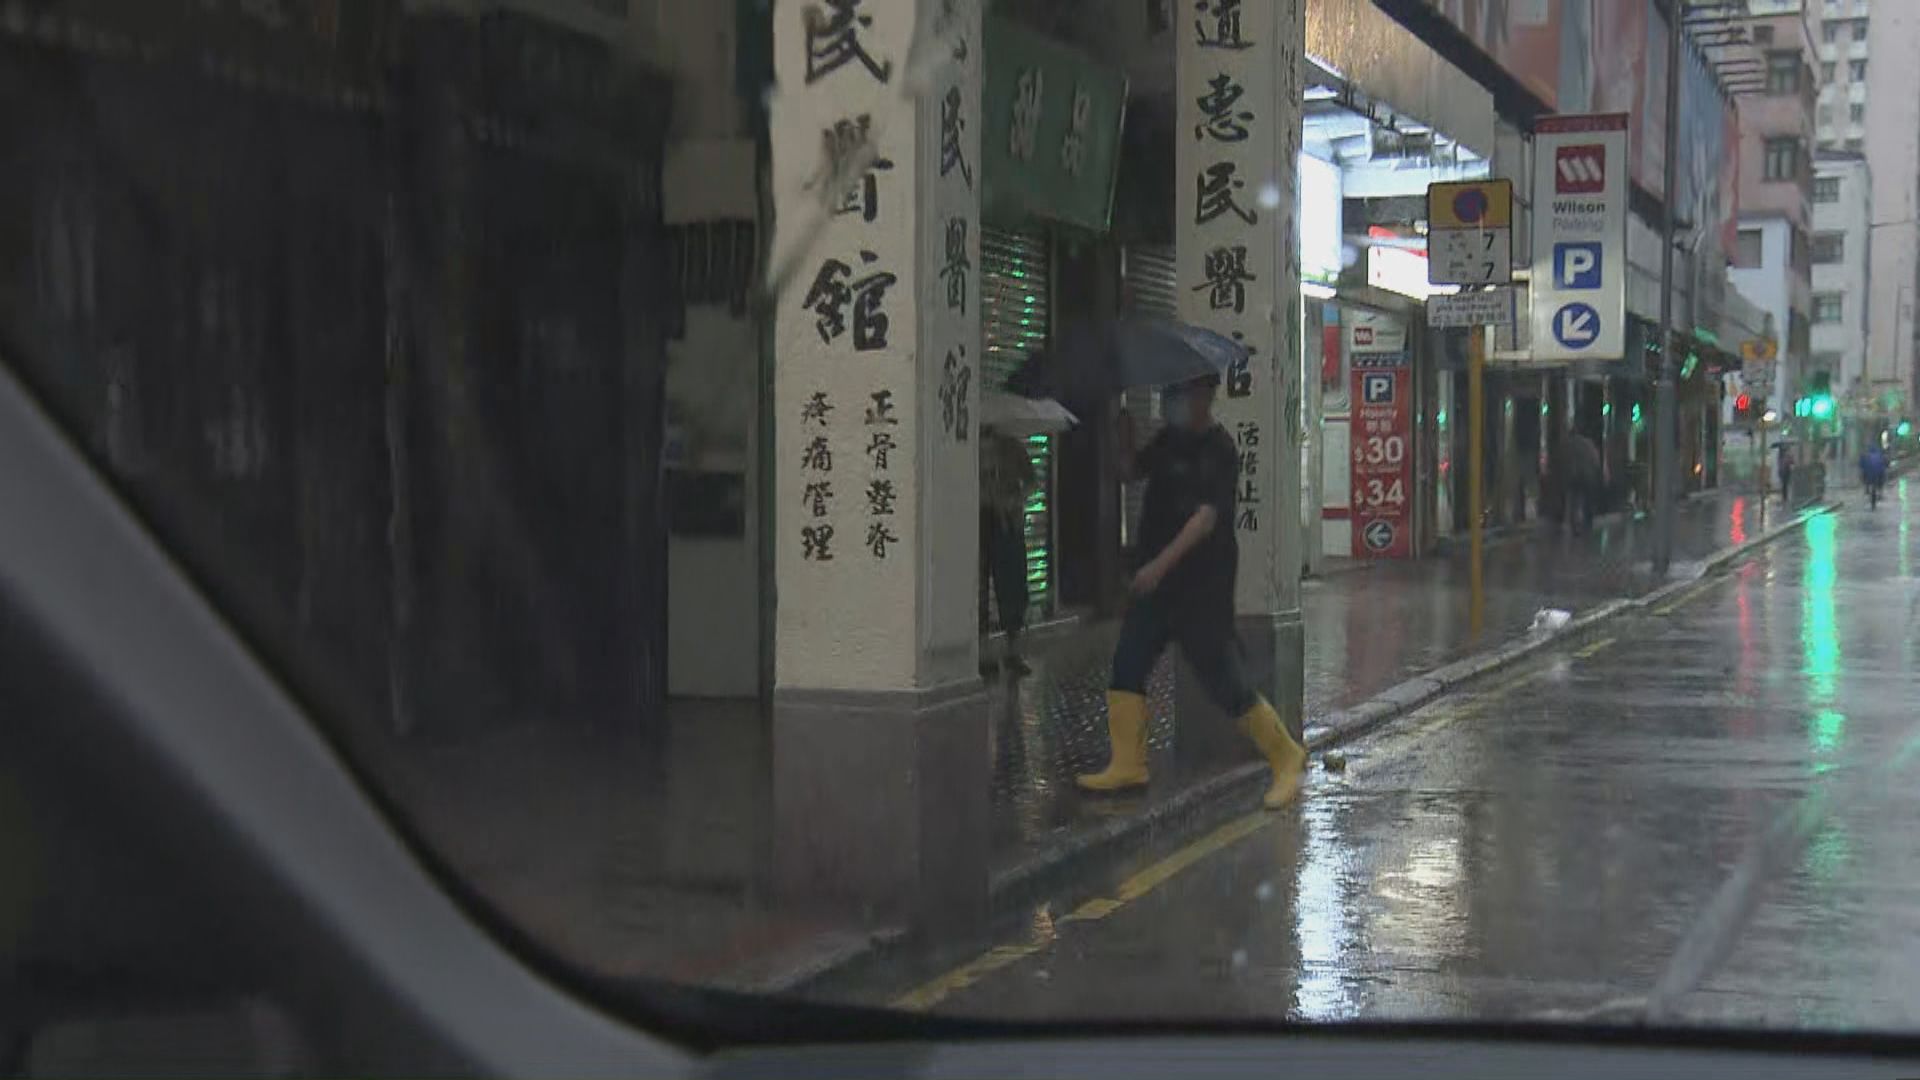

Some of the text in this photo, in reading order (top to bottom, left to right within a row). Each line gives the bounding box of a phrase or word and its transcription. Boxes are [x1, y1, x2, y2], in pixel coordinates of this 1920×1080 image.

[939, 0, 973, 441] 民醫館
[1552, 201, 1606, 214] Wilson
[1483, 232, 1495, 250] 7
[1482, 261, 1495, 279] 7
[1563, 248, 1595, 286] P
[1369, 377, 1390, 401] P
[802, 392, 834, 560] 疼痛管理
[864, 390, 898, 558] 正骨整脊
